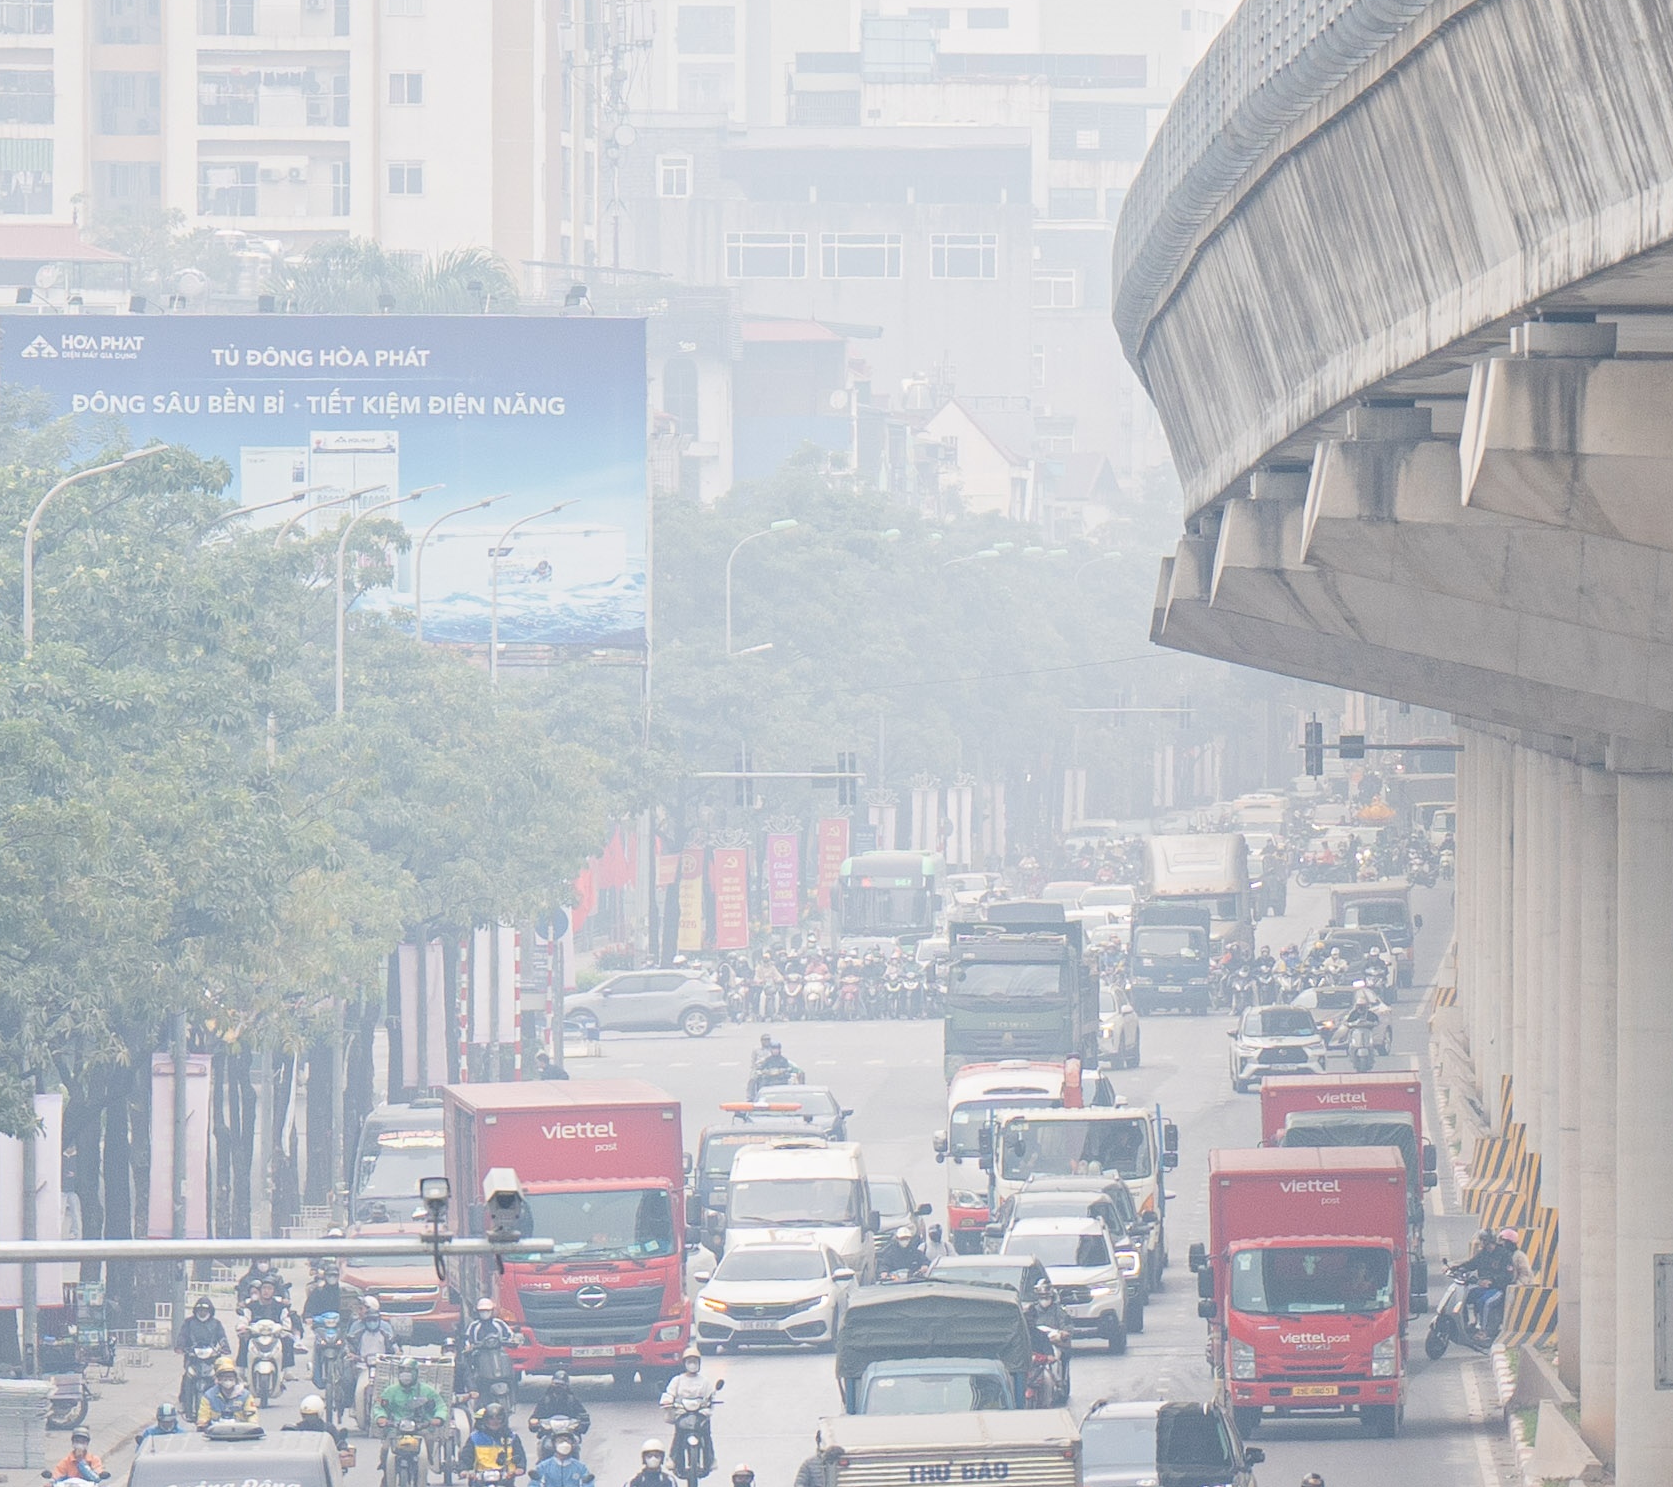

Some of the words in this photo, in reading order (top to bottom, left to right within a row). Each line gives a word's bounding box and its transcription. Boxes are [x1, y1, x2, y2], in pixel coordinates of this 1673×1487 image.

[211, 343, 240, 366] TỦ
[246, 346, 313, 367] ĐÔNG
[319, 345, 369, 367] HÒA
[375, 345, 431, 367] PHÁT
[72, 390, 146, 414] ĐÔNG
[152, 391, 201, 414] SÂU
[208, 387, 256, 414] BỀN
[264, 389, 285, 414] BỈ
[306, 387, 356, 414] TIẾT
[363, 391, 421, 420] KIỆM
[428, 392, 486, 420] ĐIỆN
[493, 391, 566, 415] NĂNG
[1317, 1092, 1367, 1104] viettel
[541, 1121, 618, 1140] viettel
[594, 1142, 618, 1153] post
[1280, 1179, 1342, 1193] viettel
[1320, 1196, 1340, 1206] post
[561, 1274, 601, 1285] viettel
[601, 1275, 621, 1284] post
[1279, 1332, 1326, 1344] viettel
[1327, 1334, 1351, 1344] post
